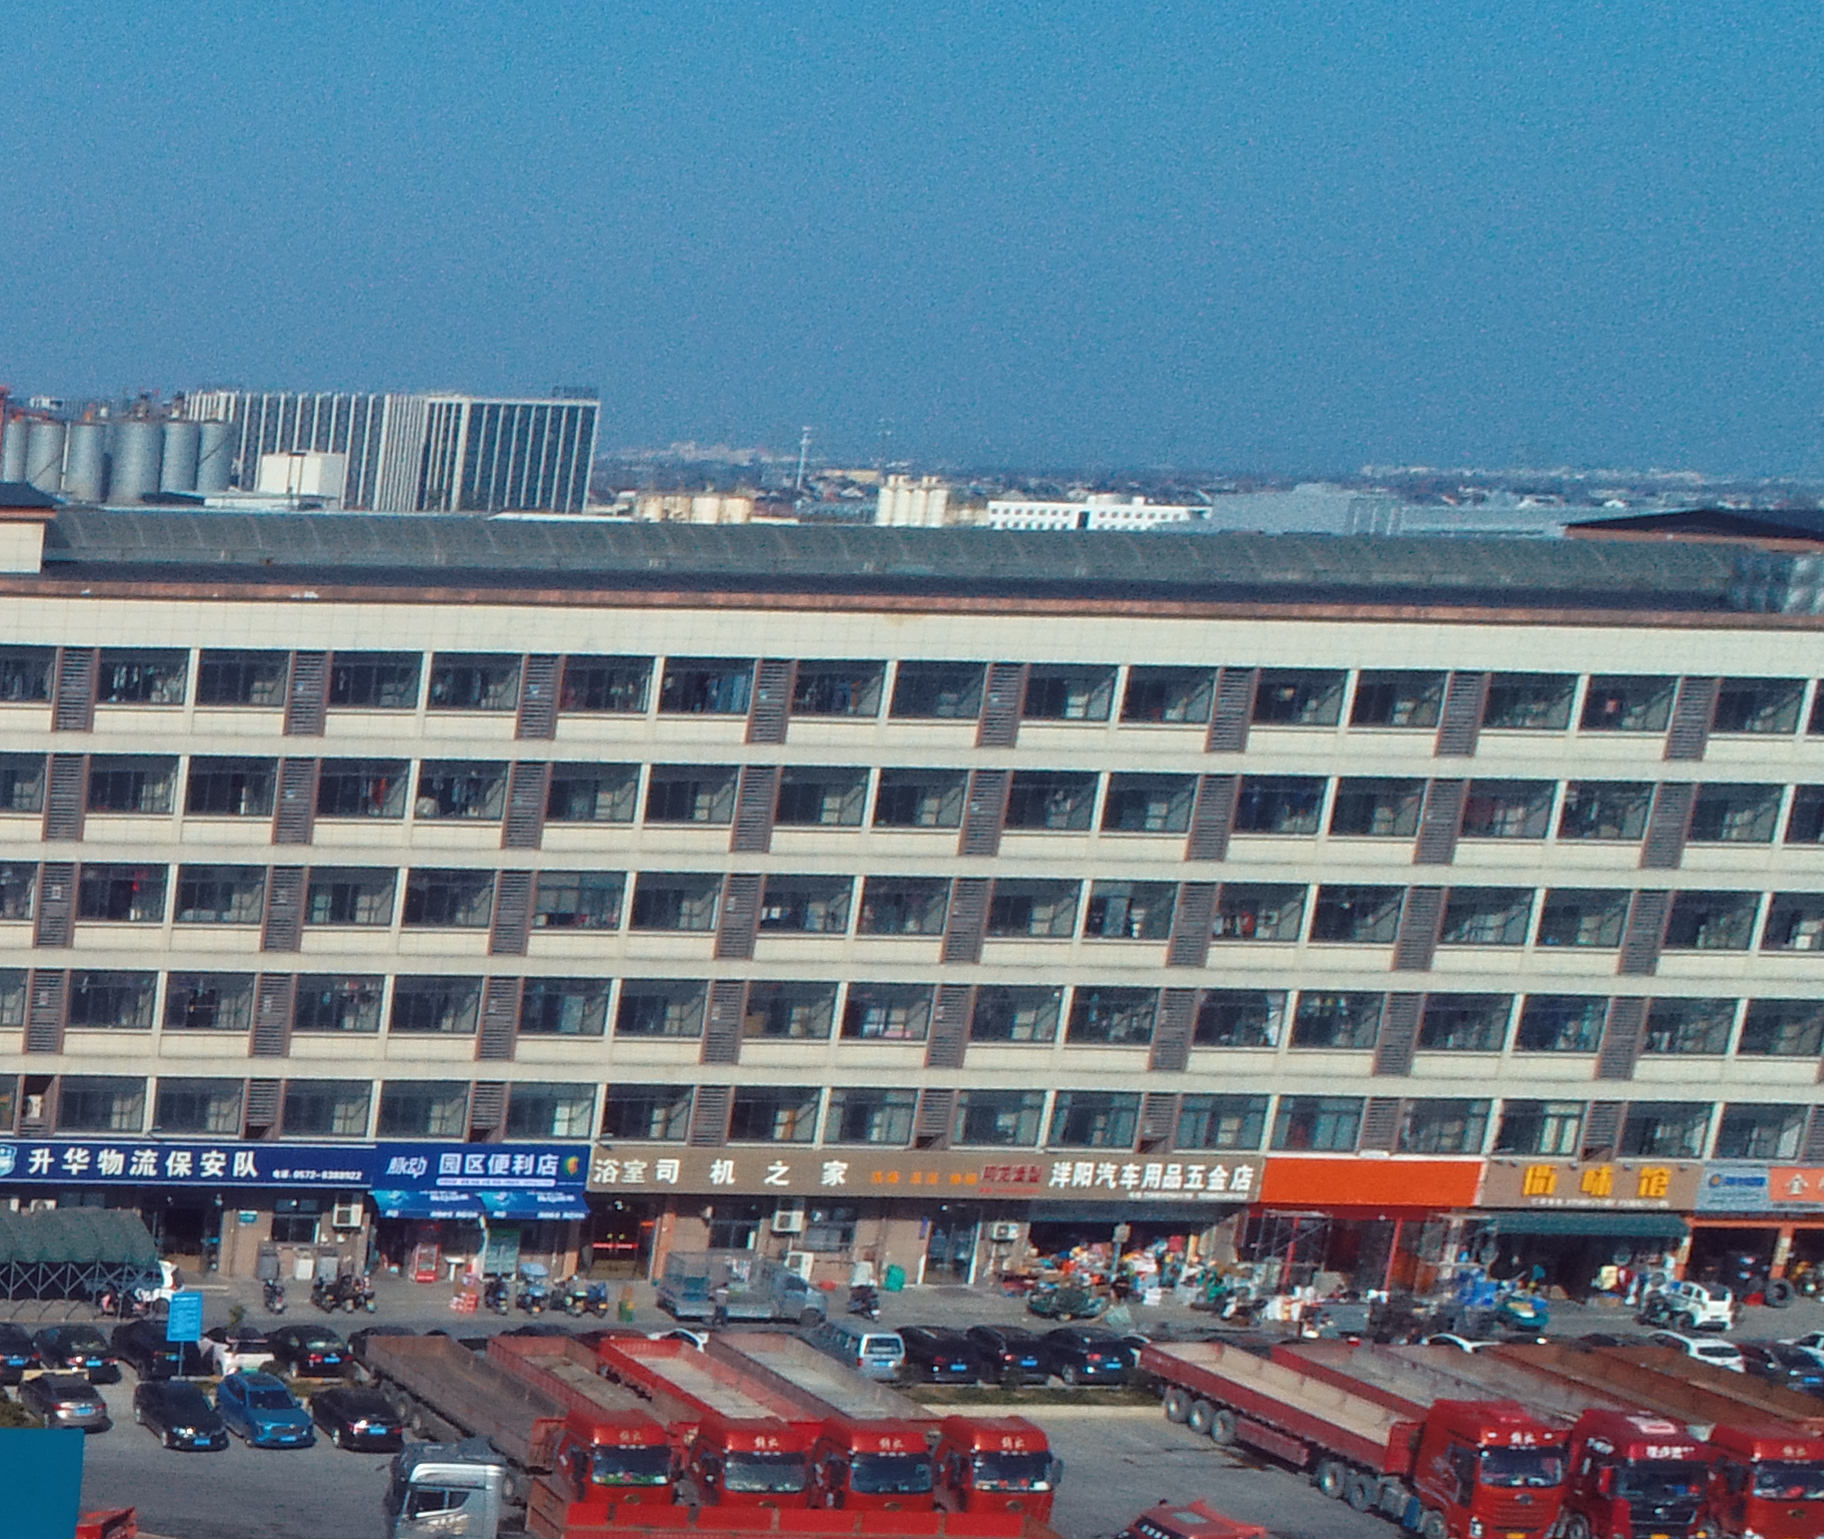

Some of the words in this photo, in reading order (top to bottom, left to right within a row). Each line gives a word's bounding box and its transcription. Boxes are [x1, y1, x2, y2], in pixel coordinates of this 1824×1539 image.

[28, 1147, 258, 1178] 升华物流保安队
[386, 1156, 428, 1177] 脉动
[439, 1153, 559, 1176] 园区便利店
[655, 1158, 849, 1187] 司机之家
